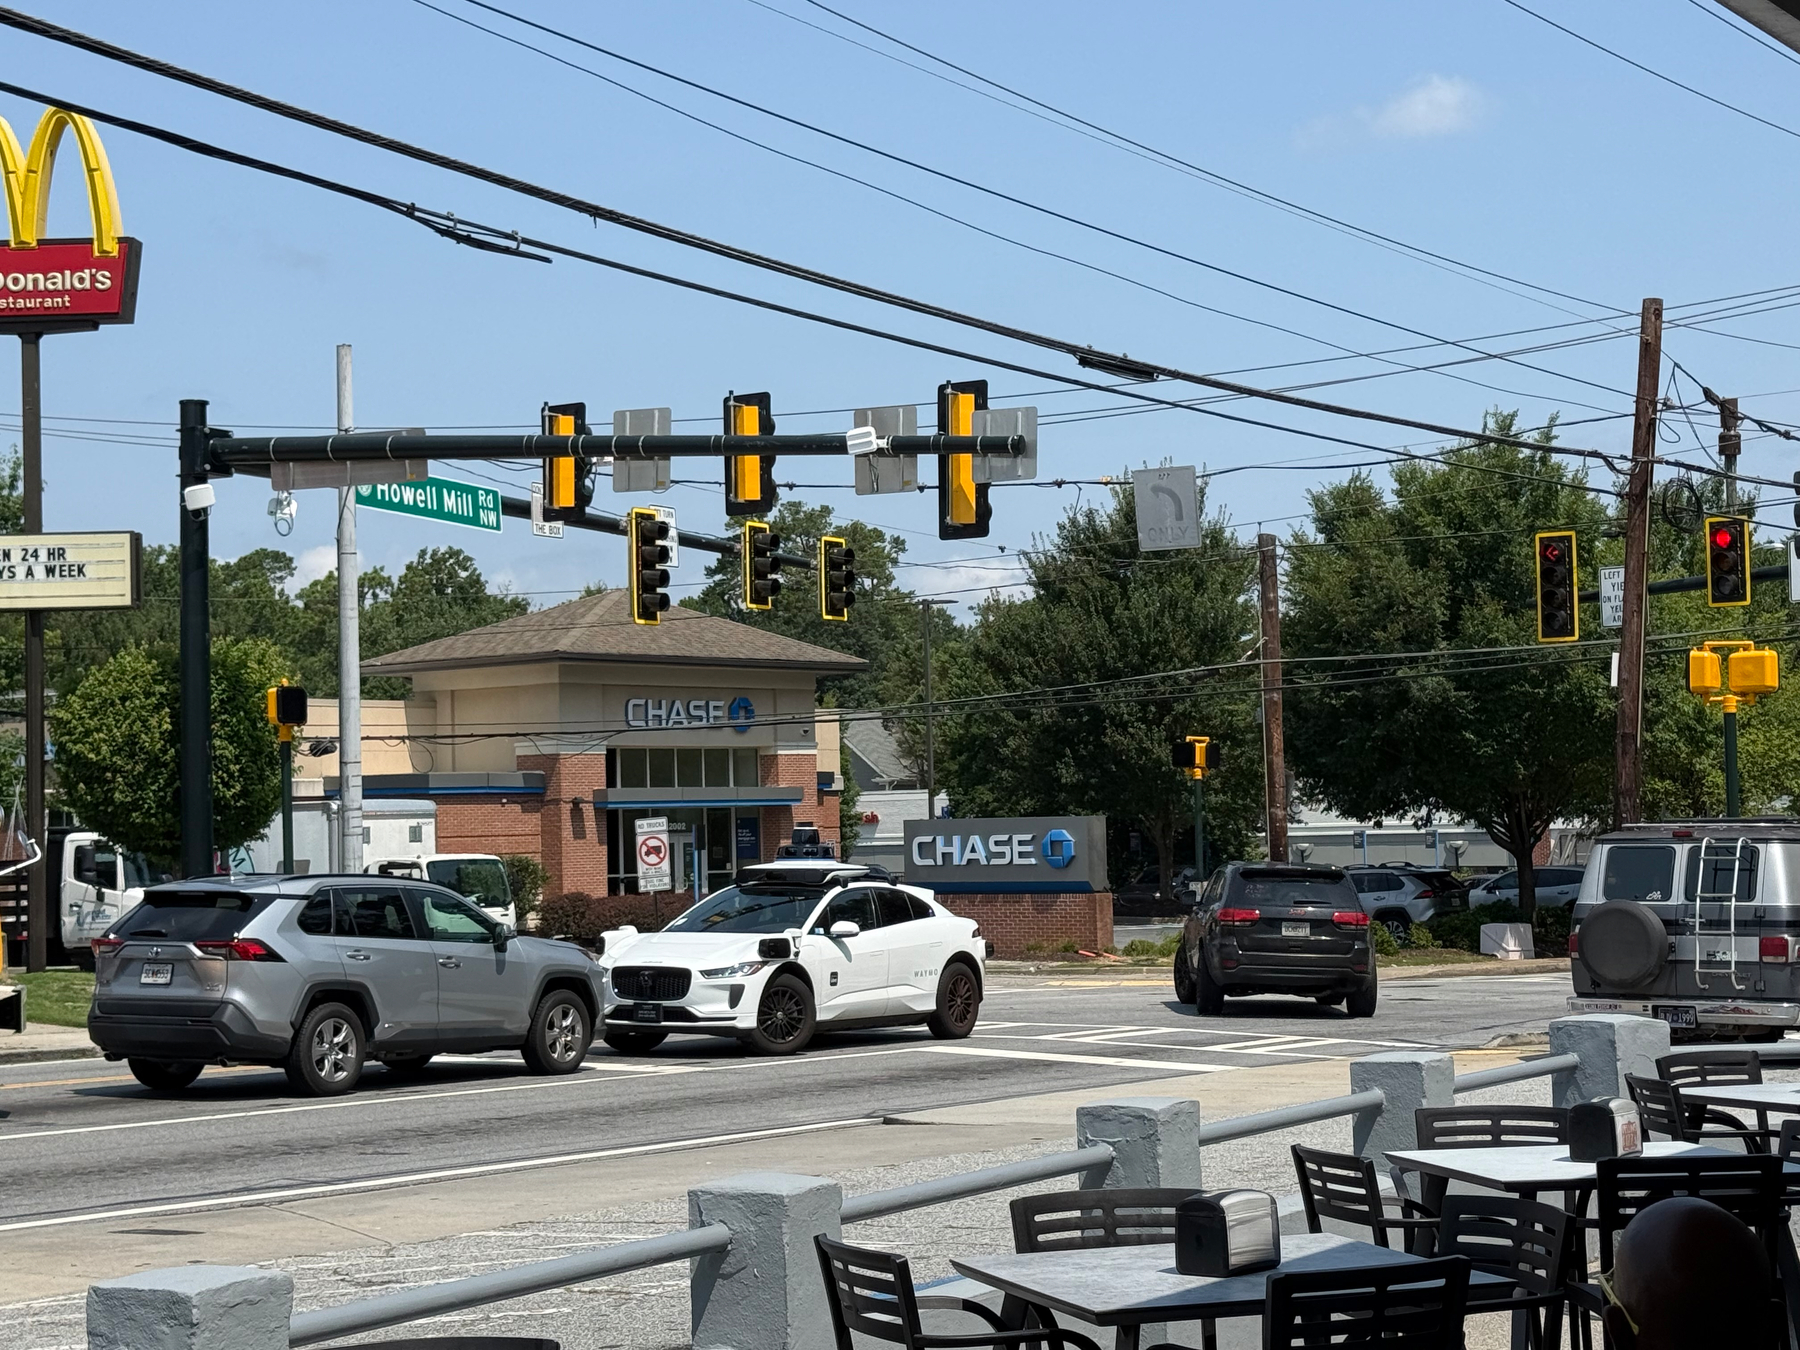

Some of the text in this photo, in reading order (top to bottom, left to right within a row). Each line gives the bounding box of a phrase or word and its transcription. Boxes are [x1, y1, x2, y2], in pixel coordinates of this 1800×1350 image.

[0, 268, 112, 292] onald's
[376, 483, 473, 517] Howell Mill
[478, 490, 494, 509] Rd
[480, 508, 497, 527] NW
[535, 523, 561, 535] THE BOX
[1148, 526, 1190, 542] ONLY
[21, 548, 39, 561] 24
[47, 547, 67, 561] HR
[26, 565, 35, 578] A
[45, 563, 87, 578] WEEK
[1604, 571, 1620, 580] LEFT
[1602, 595, 1612, 603] ON
[625, 698, 725, 728] CHASE
[646, 821, 665, 829] TRUCKS
[668, 822, 686, 830] 2002
[912, 834, 1037, 866] CHASE
[913, 969, 938, 977] WAYMO
